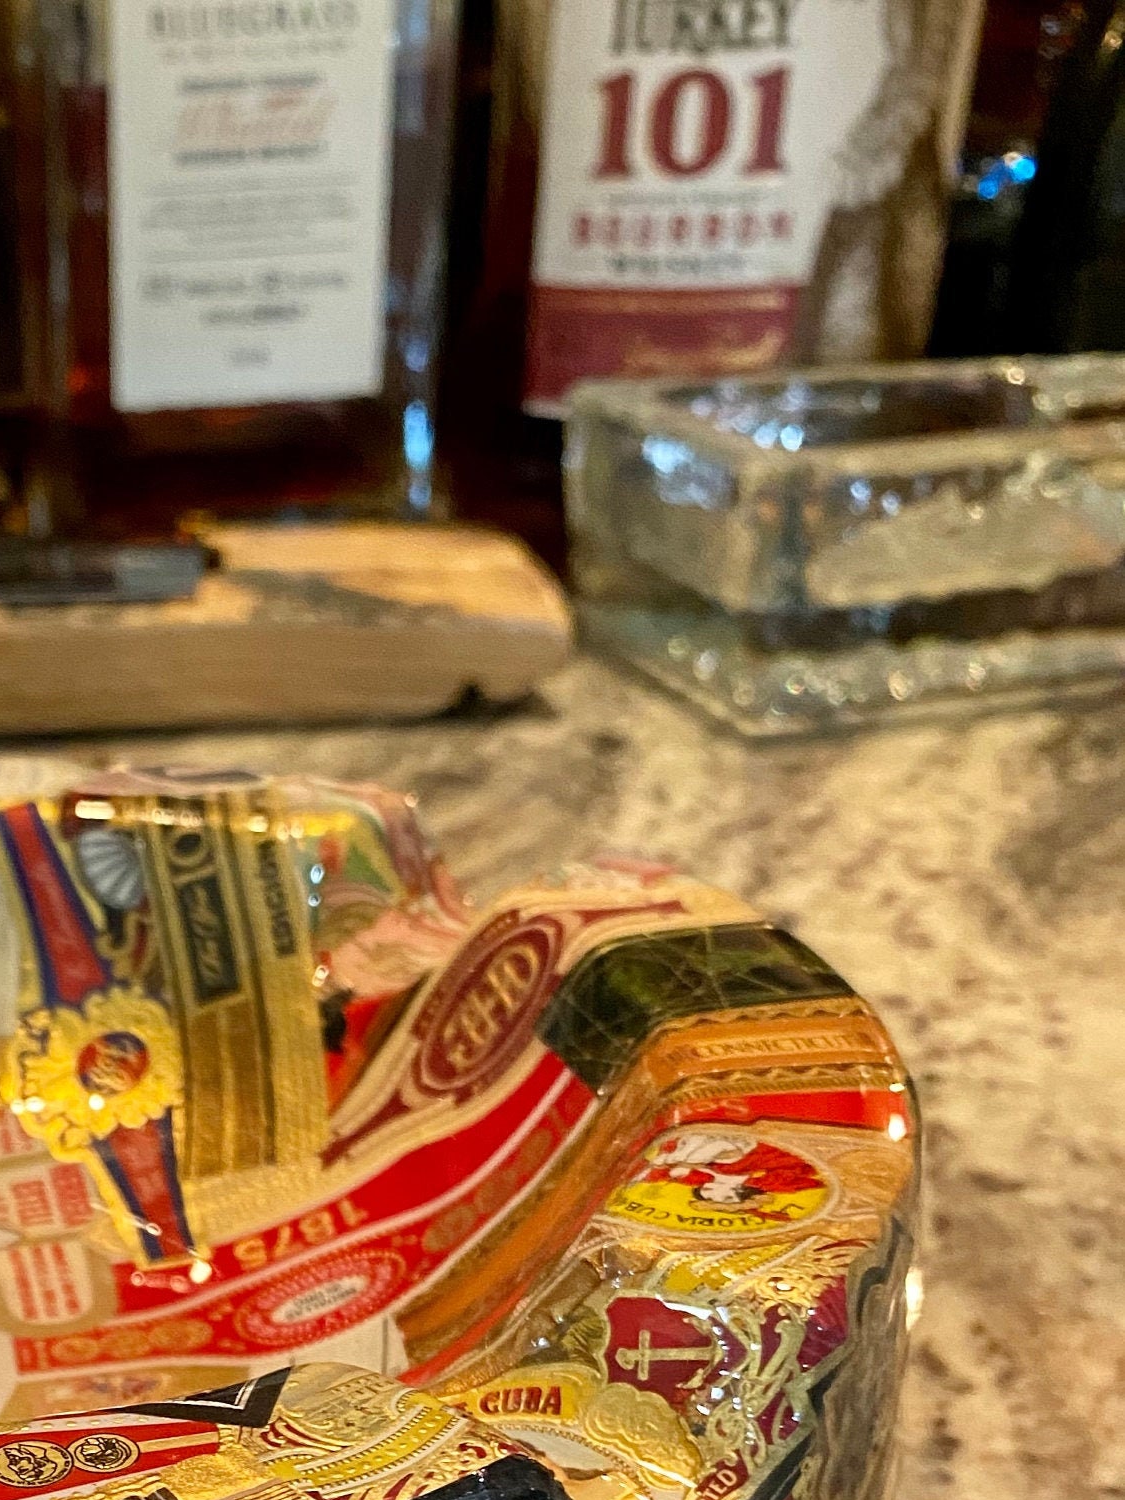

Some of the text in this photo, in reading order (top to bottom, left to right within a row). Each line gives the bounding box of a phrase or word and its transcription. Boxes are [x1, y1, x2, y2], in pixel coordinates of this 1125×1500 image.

[587, 64, 791, 183] 101
[233, 1199, 369, 1272] 1875
[479, 1385, 562, 1416] CUBA
